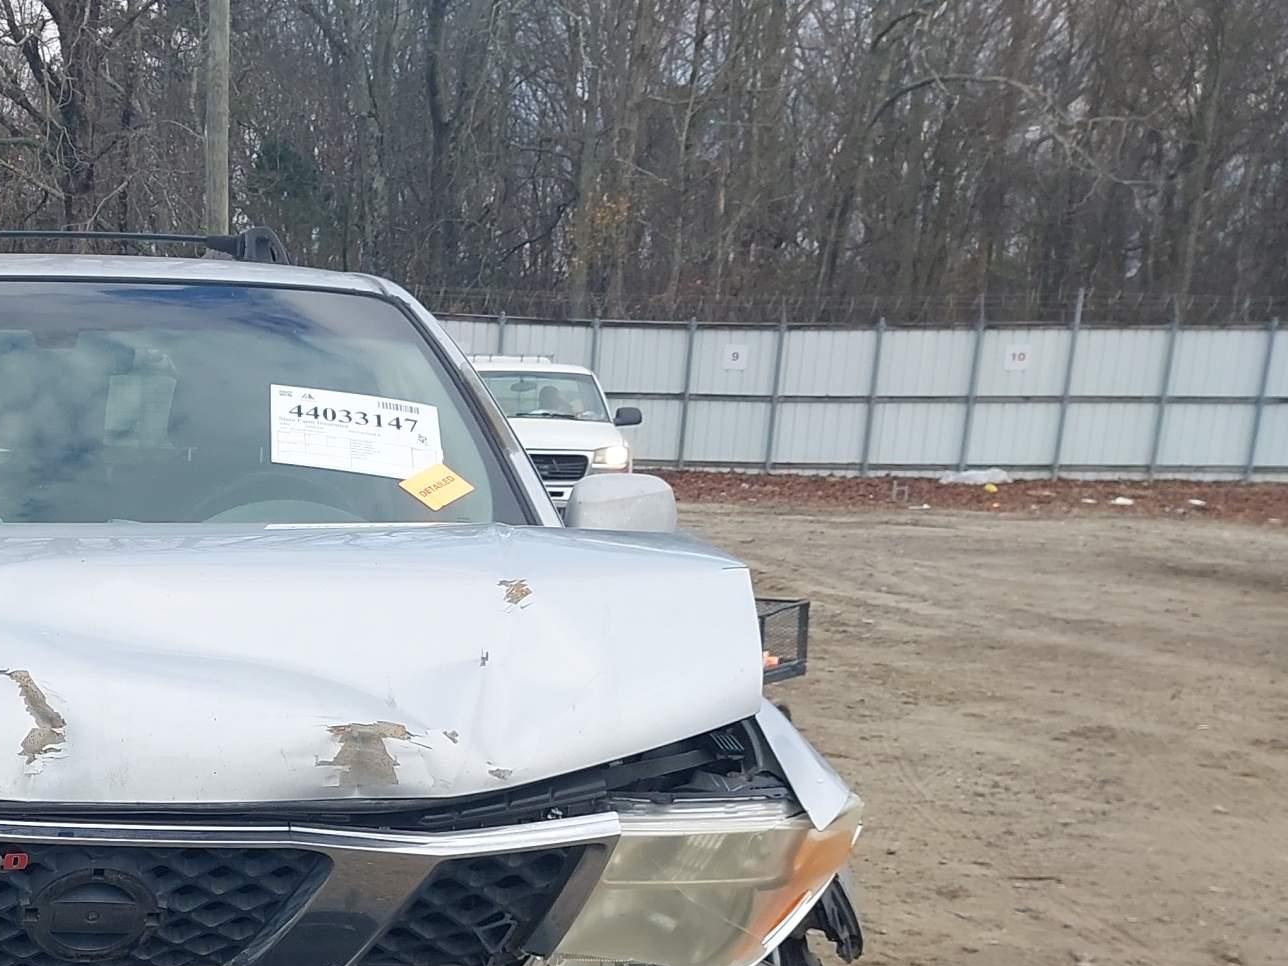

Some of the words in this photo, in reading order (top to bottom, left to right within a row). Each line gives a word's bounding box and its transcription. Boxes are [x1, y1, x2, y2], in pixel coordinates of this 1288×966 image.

[731, 351, 739, 362] 9
[1011, 351, 1026, 362] 10
[288, 404, 418, 433] 44033147
[418, 475, 456, 498] DETAILED
